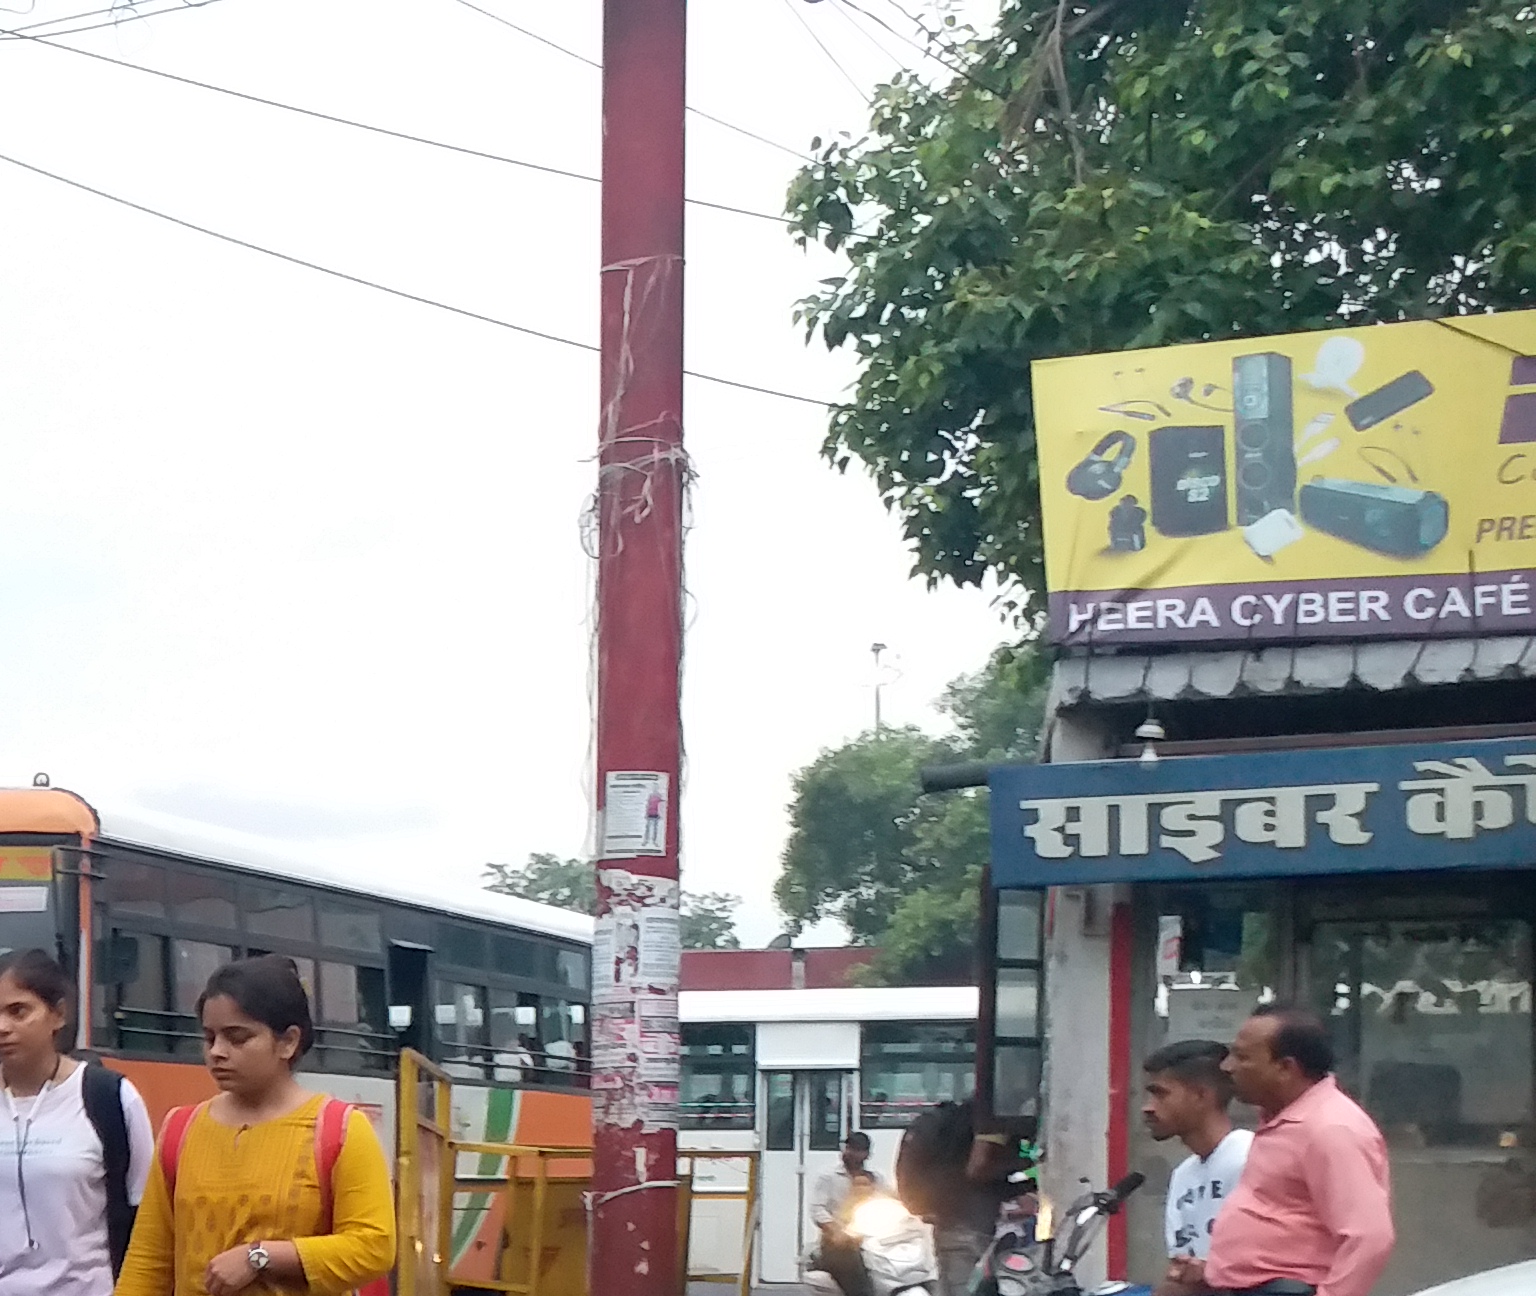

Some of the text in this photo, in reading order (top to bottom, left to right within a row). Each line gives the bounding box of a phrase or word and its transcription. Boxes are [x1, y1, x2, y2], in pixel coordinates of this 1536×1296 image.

[1067, 574, 1532, 632] HEERA CYBER CAFÉ
[1019, 783, 1380, 862] साइबर
